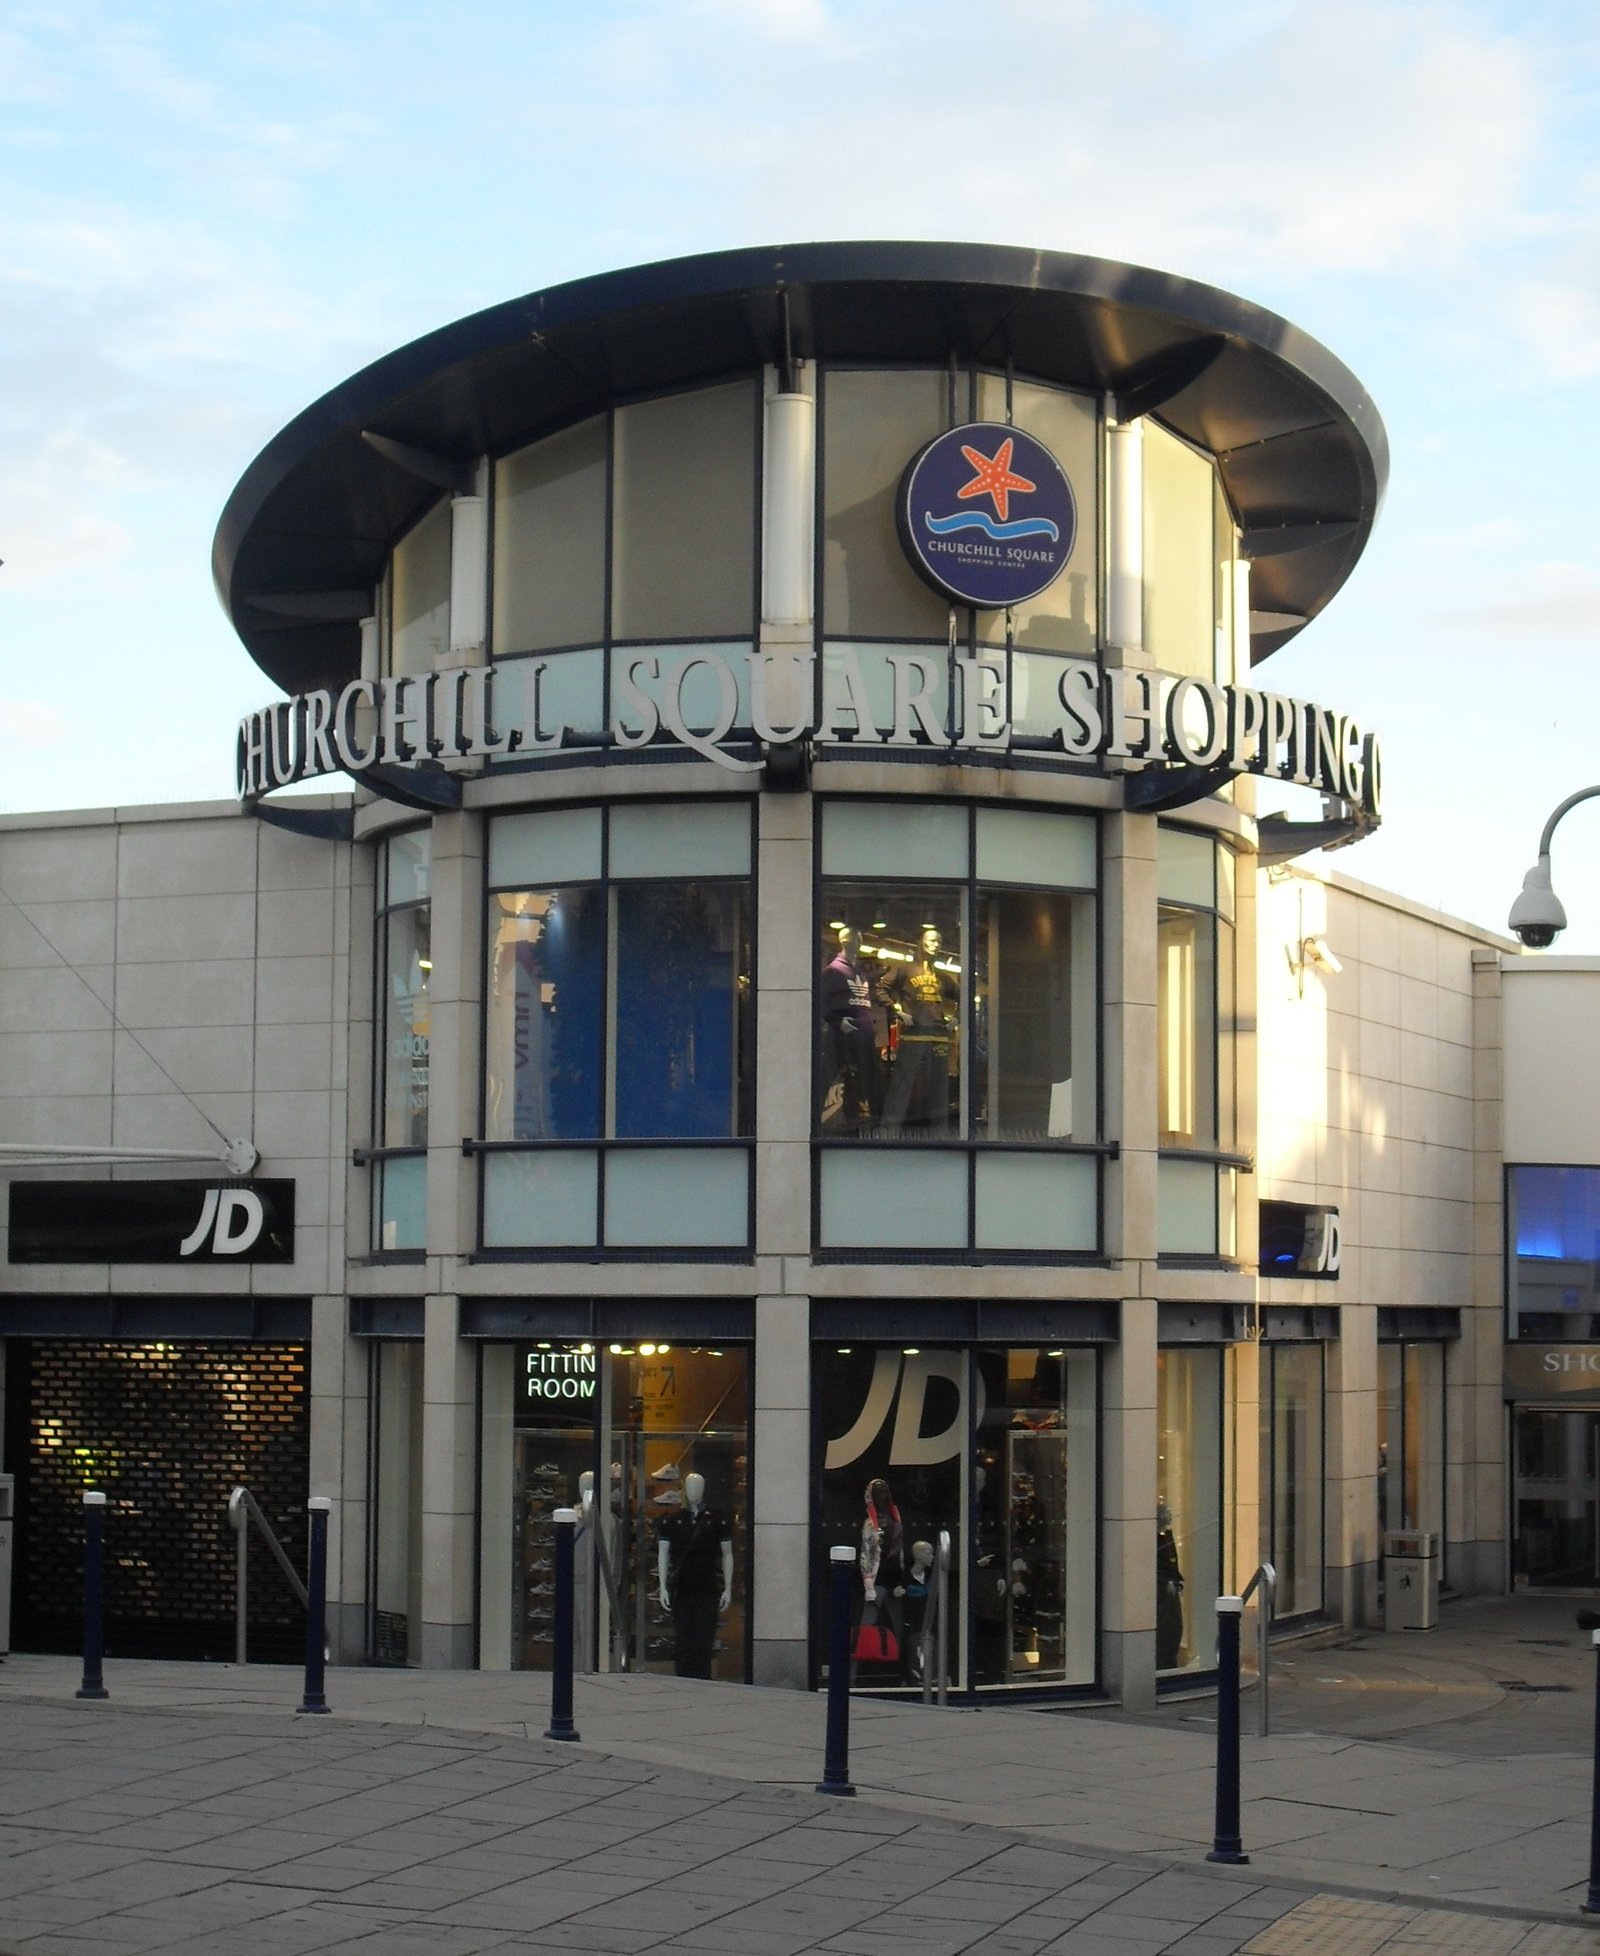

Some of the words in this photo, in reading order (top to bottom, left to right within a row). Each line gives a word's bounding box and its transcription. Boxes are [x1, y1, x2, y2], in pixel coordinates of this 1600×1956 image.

[928, 540, 1002, 557] CHURCHILL
[1007, 547, 1055, 562] SQUARE
[235, 663, 564, 801] CHURCHILL
[612, 650, 1010, 772] SQUARE
[1058, 662, 1364, 806] SHOPPING
[180, 1189, 263, 1256] JD
[1318, 1213, 1341, 1273] JD
[527, 1353, 596, 1374] FITTIN
[824, 1349, 986, 1470] JD
